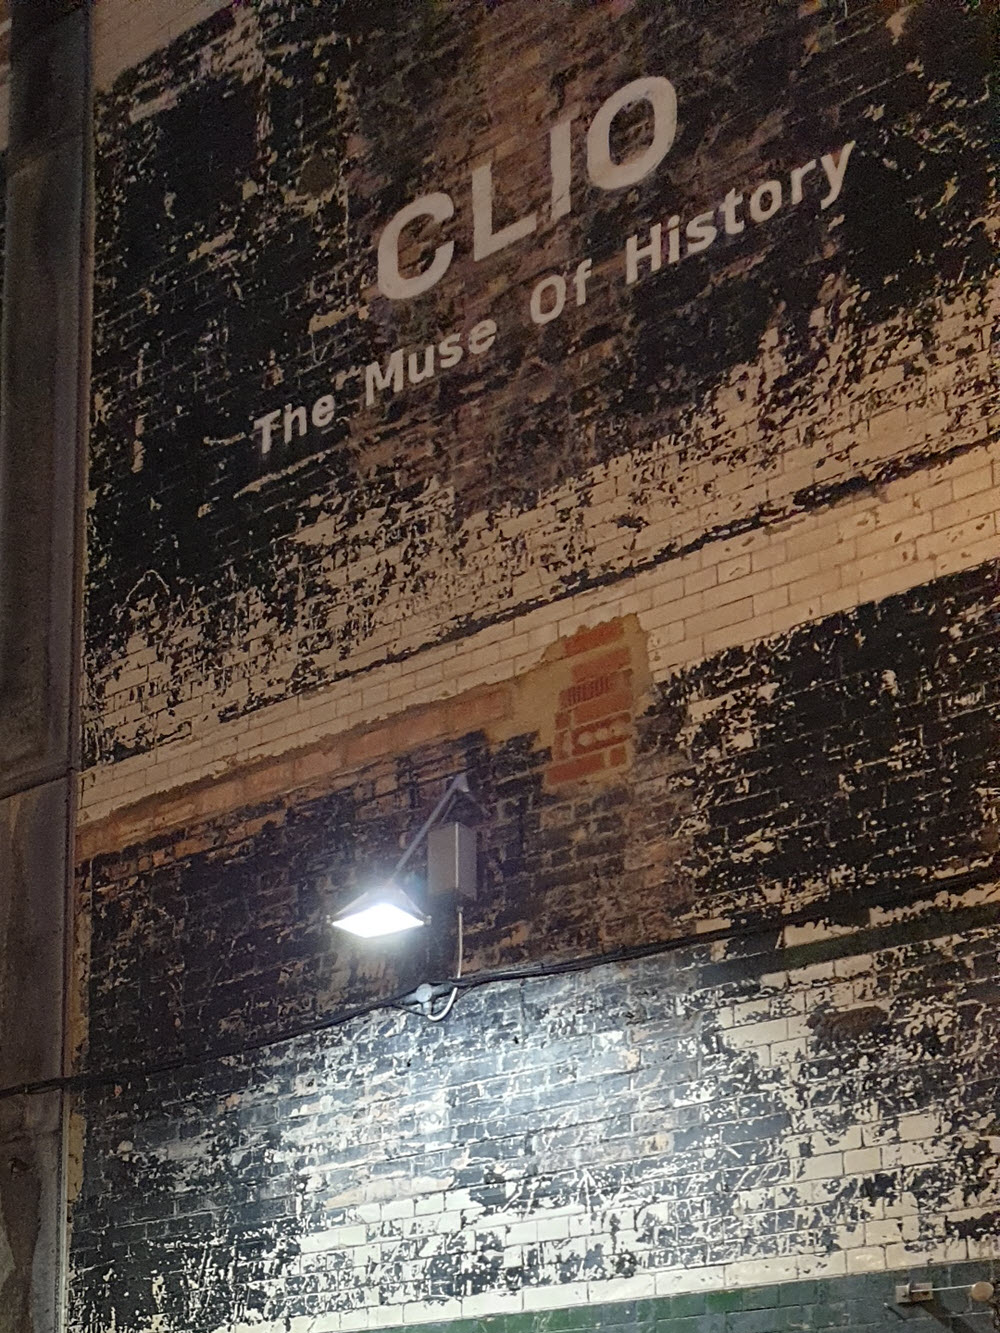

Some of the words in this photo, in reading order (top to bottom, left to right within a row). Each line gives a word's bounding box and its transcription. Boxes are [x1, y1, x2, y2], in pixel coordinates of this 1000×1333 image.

[253, 394, 336, 455] The
[364, 317, 498, 407] Muse
[529, 257, 595, 325] Of
[624, 140, 856, 285] History
[376, 75, 678, 302] CLIO
